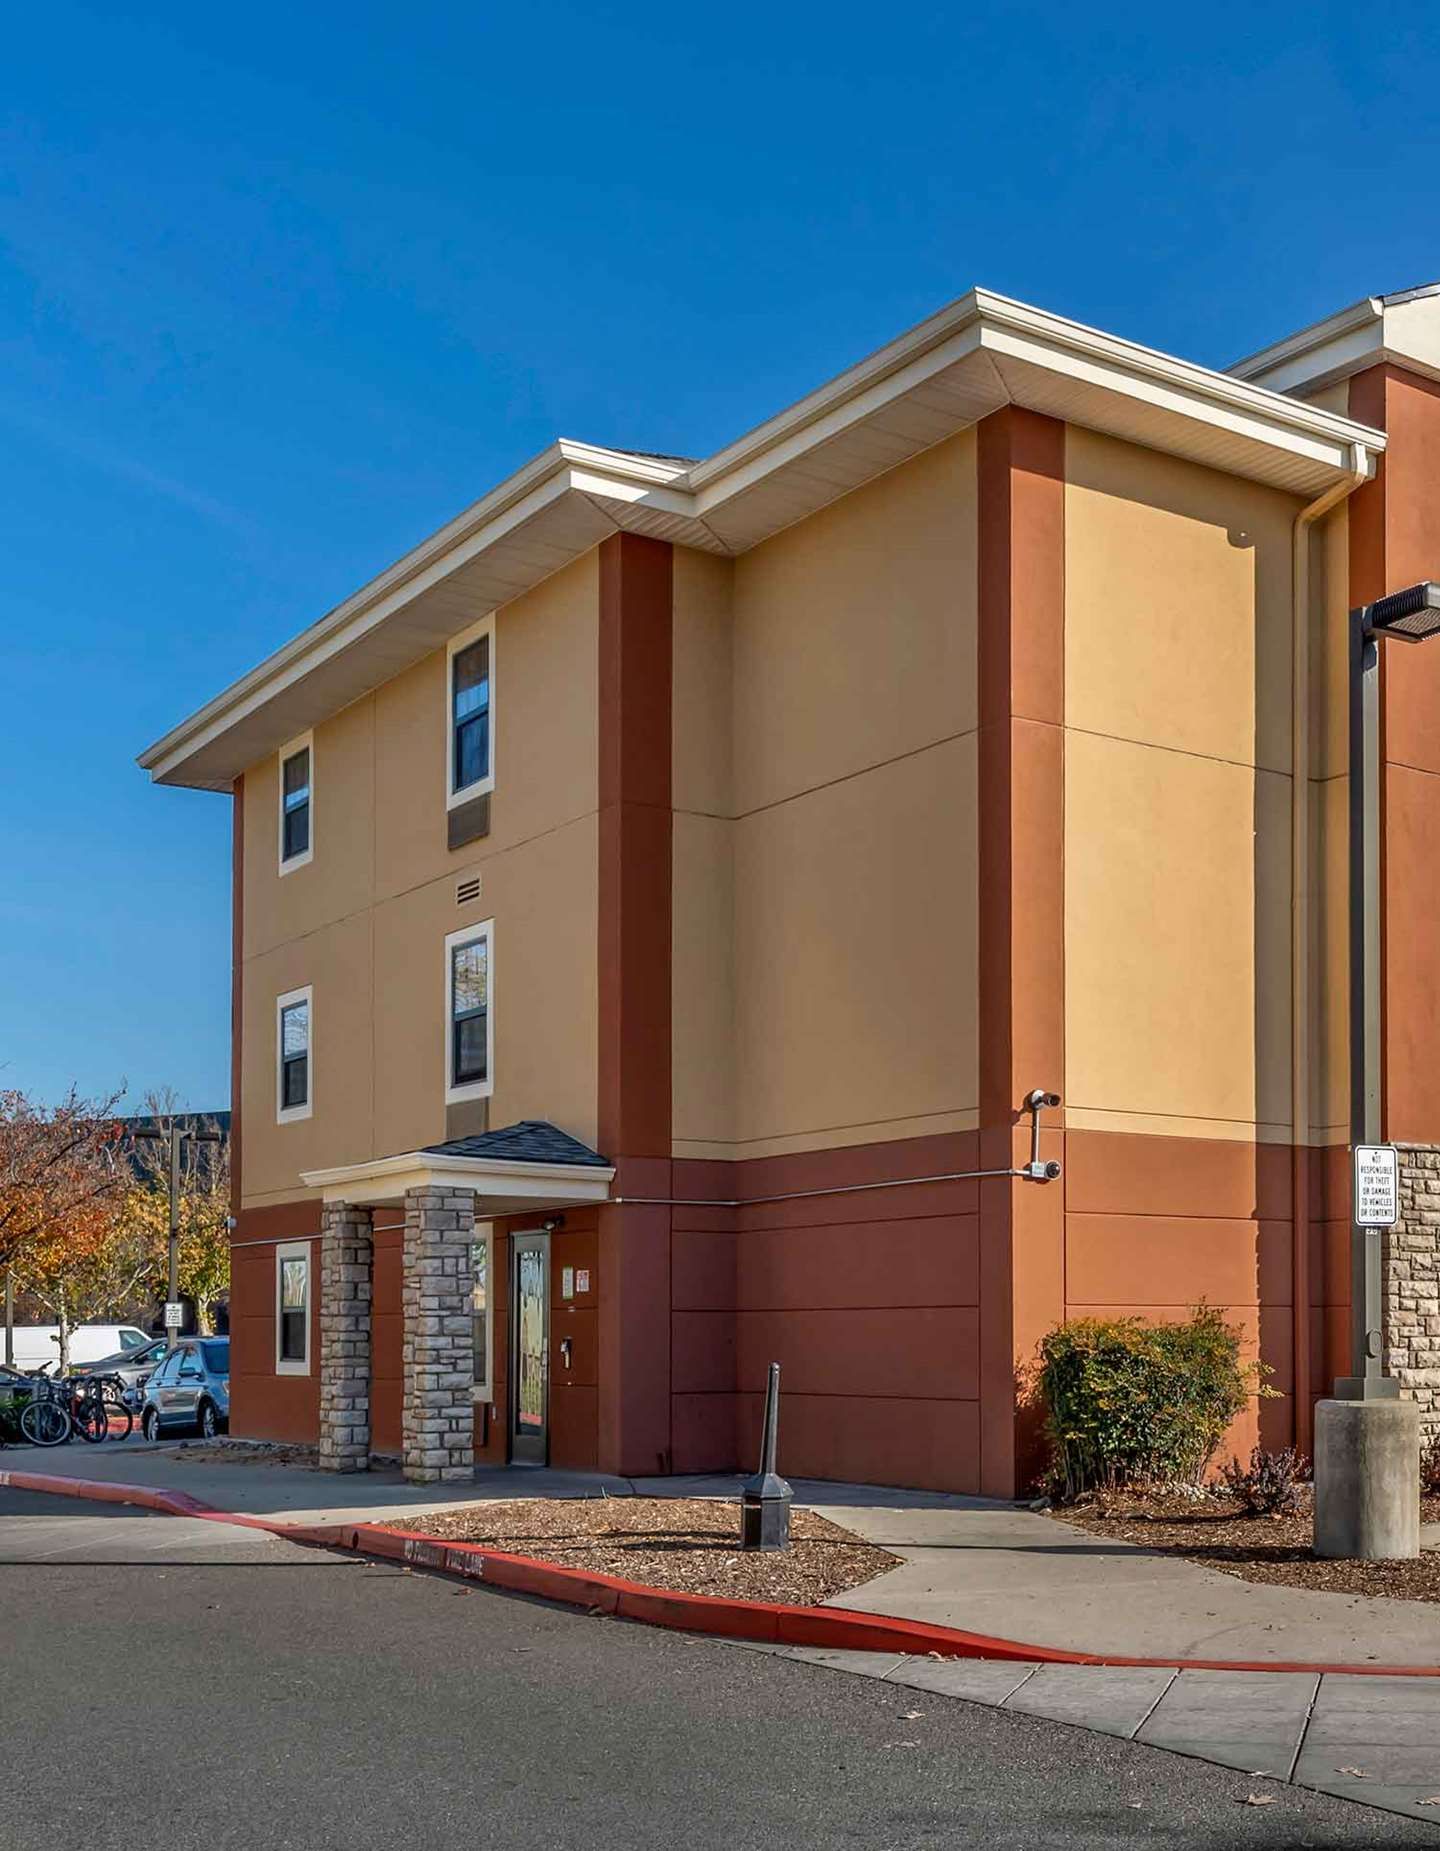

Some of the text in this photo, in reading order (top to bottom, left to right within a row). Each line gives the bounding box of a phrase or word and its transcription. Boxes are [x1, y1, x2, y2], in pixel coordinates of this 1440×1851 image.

[1371, 1155, 1381, 1163] NOT
[1361, 1165, 1392, 1174] RESPONSIBLE
[1364, 1176, 1390, 1184] FOR THEFT
[1363, 1187, 1391, 1195] OR DAMAGE
[1361, 1197, 1392, 1206] TO VEHICLES
[1361, 1208, 1393, 1217] OR CONTENTS
